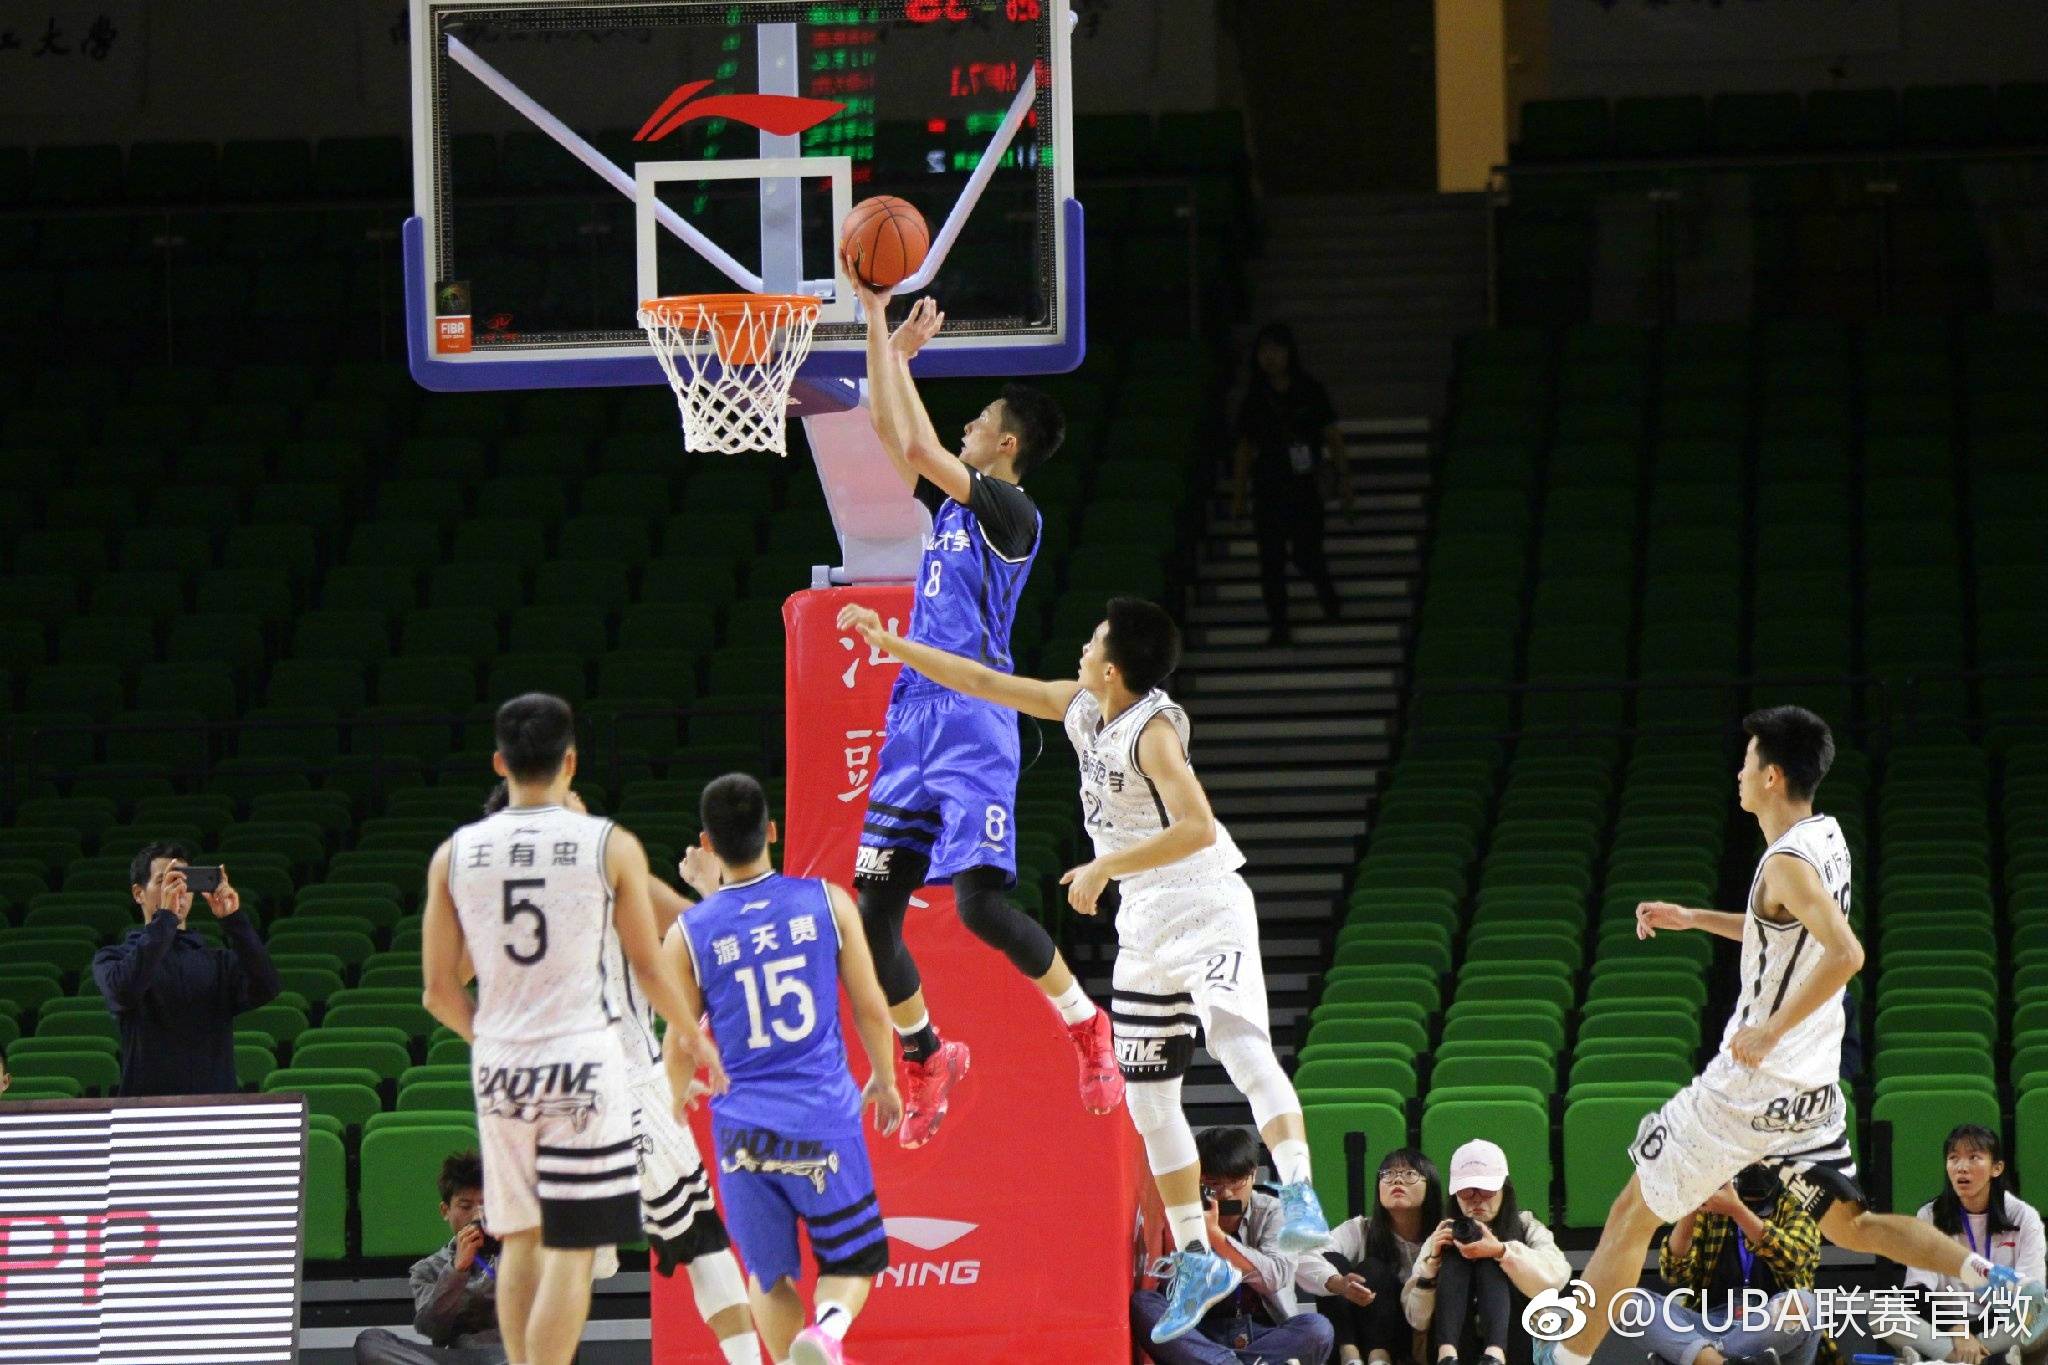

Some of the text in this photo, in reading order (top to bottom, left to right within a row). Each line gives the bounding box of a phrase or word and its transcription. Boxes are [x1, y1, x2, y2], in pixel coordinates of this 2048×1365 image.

[441, 322, 465, 334] FIBA
[924, 560, 942, 597] 8
[985, 804, 1007, 842] 8
[468, 841, 578, 868] 王有忠
[503, 878, 548, 966] 5
[1205, 951, 1242, 984] 21
[735, 954, 816, 1049] 15
[1640, 1125, 1667, 1160] 6
